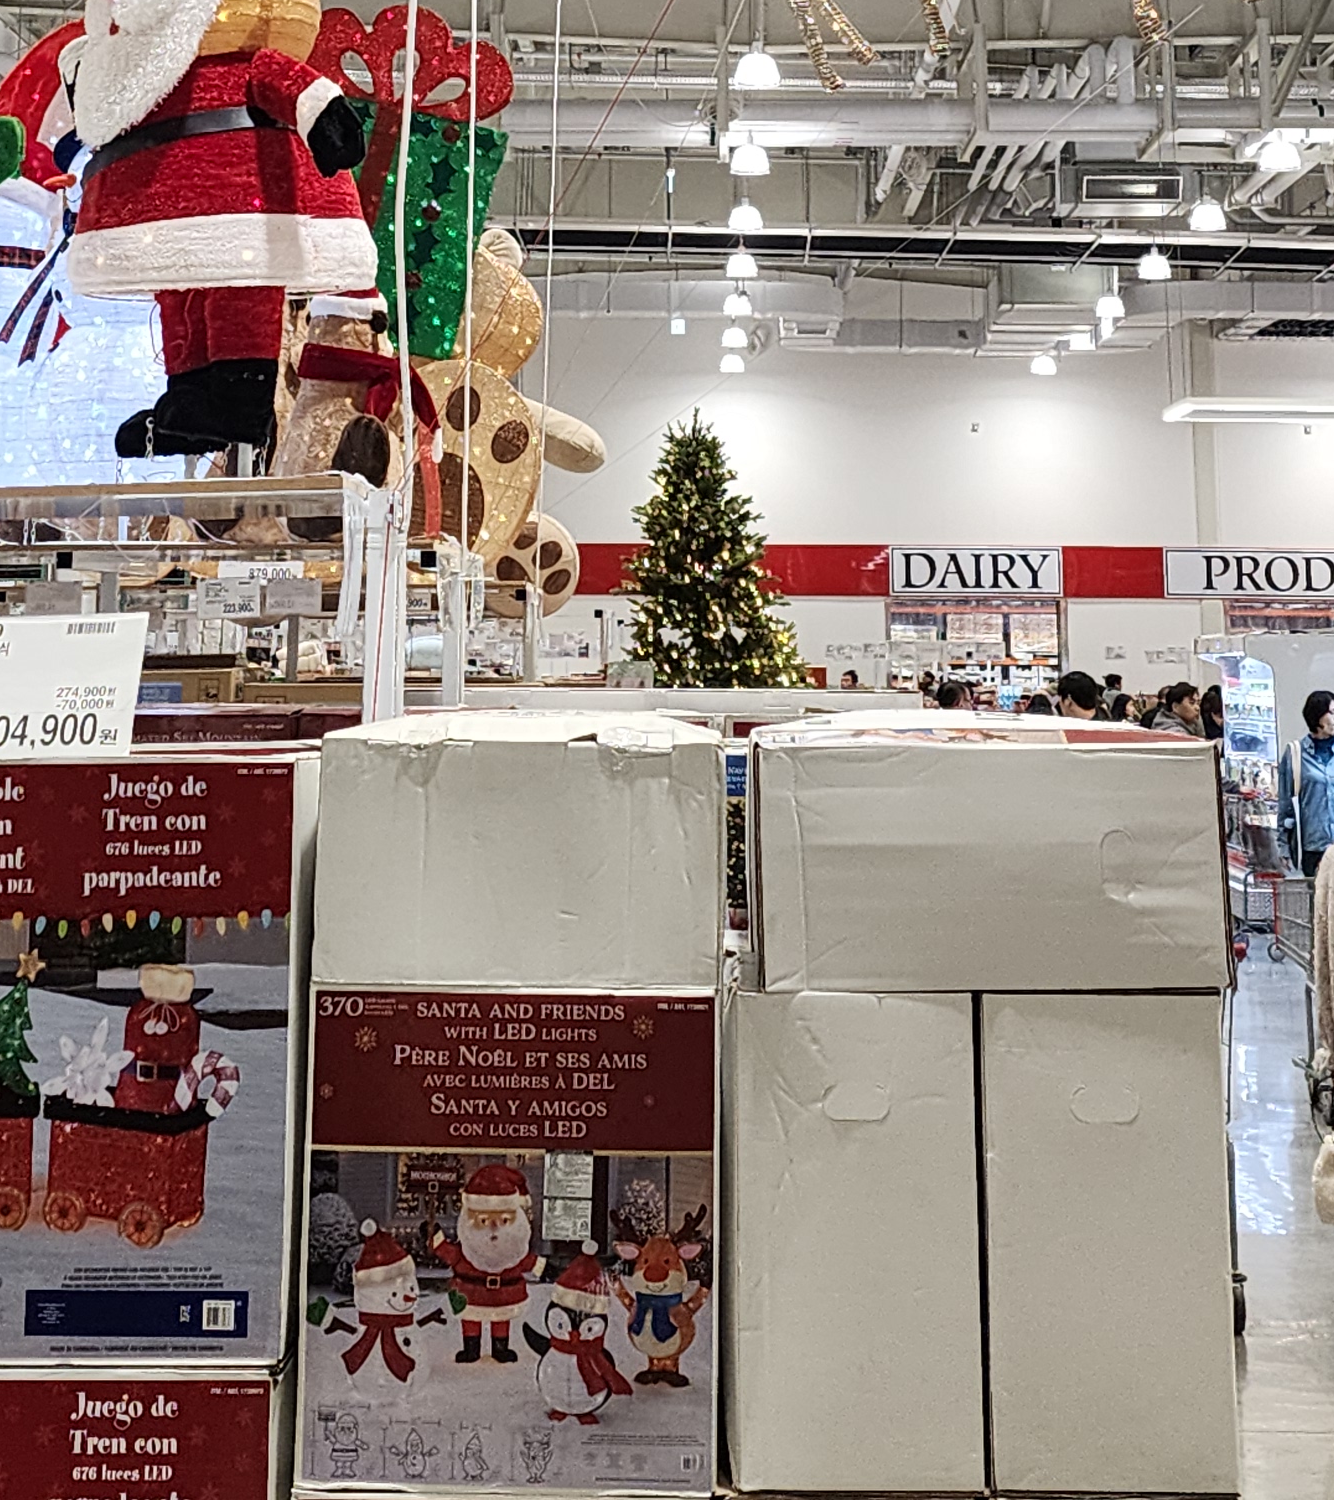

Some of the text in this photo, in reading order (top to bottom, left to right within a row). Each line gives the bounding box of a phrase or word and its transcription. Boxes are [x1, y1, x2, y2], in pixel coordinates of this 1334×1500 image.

[901, 552, 1050, 590] DAIRY
[103, 773, 208, 809] Juego de
[102, 808, 207, 832] Tren con
[105, 839, 203, 856] 676 luces LED
[7, 879, 35, 894] DEL
[82, 864, 222, 897] parpadeante
[319, 995, 365, 1017] 370
[416, 1002, 482, 1019] SANTA
[489, 1003, 534, 1019] AND
[540, 1003, 625, 1021] FRIENDS
[493, 1023, 536, 1041] LED
[542, 1027, 597, 1042] LIGHTS
[524, 1052, 549, 1068] ET
[555, 1052, 590, 1069] SES
[598, 1053, 647, 1070] AMIS
[423, 1073, 467, 1088] AVEC
[572, 1073, 615, 1091] DEL
[430, 1092, 608, 1117] SANTA Y AMIGOS
[449, 1120, 587, 1138] CON LUCES LED
[70, 1391, 179, 1431] Juego de
[69, 1429, 178, 1455] Tren con
[72, 1463, 173, 1482] 676 luces LED
